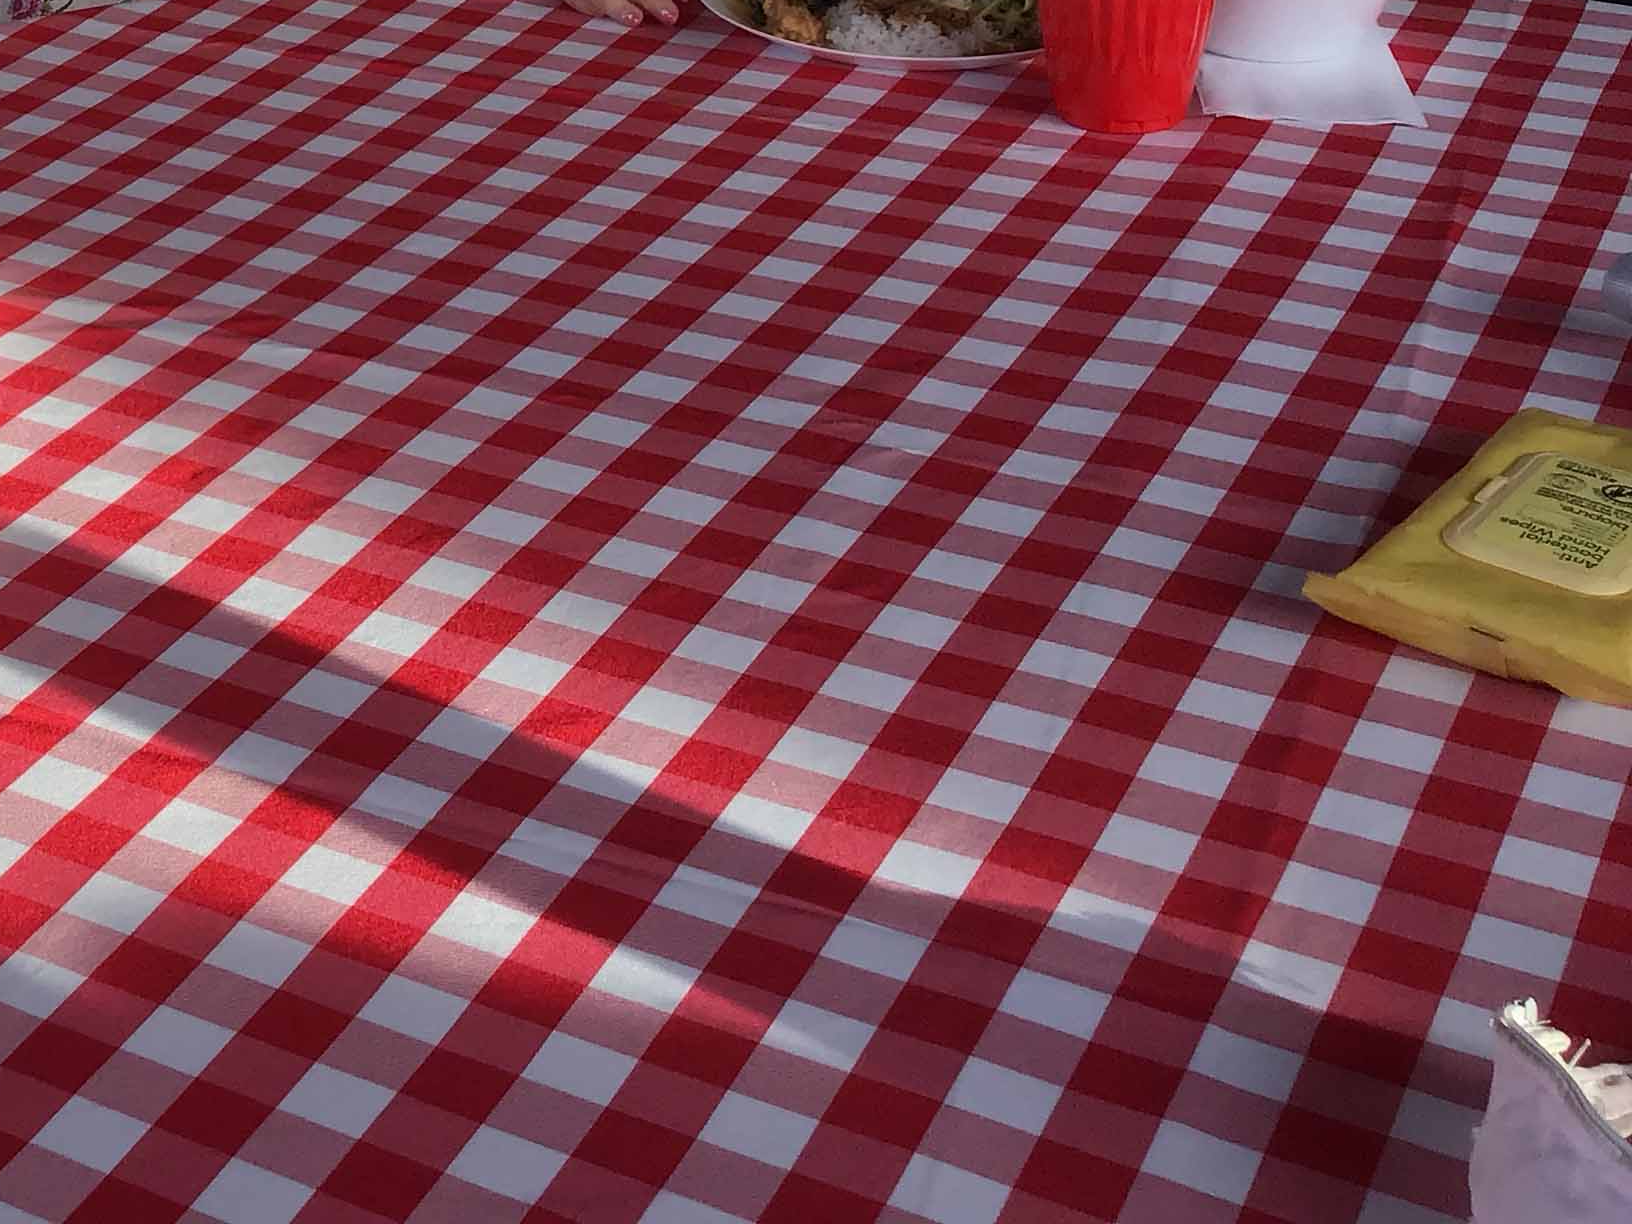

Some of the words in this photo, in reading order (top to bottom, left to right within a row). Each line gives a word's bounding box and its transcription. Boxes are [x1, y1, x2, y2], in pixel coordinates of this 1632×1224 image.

[1499, 516, 1553, 538] Wipes
[1520, 530, 1604, 563] bacterial
[1559, 535, 1611, 556] Hand
[1553, 551, 1598, 569] Anti-
